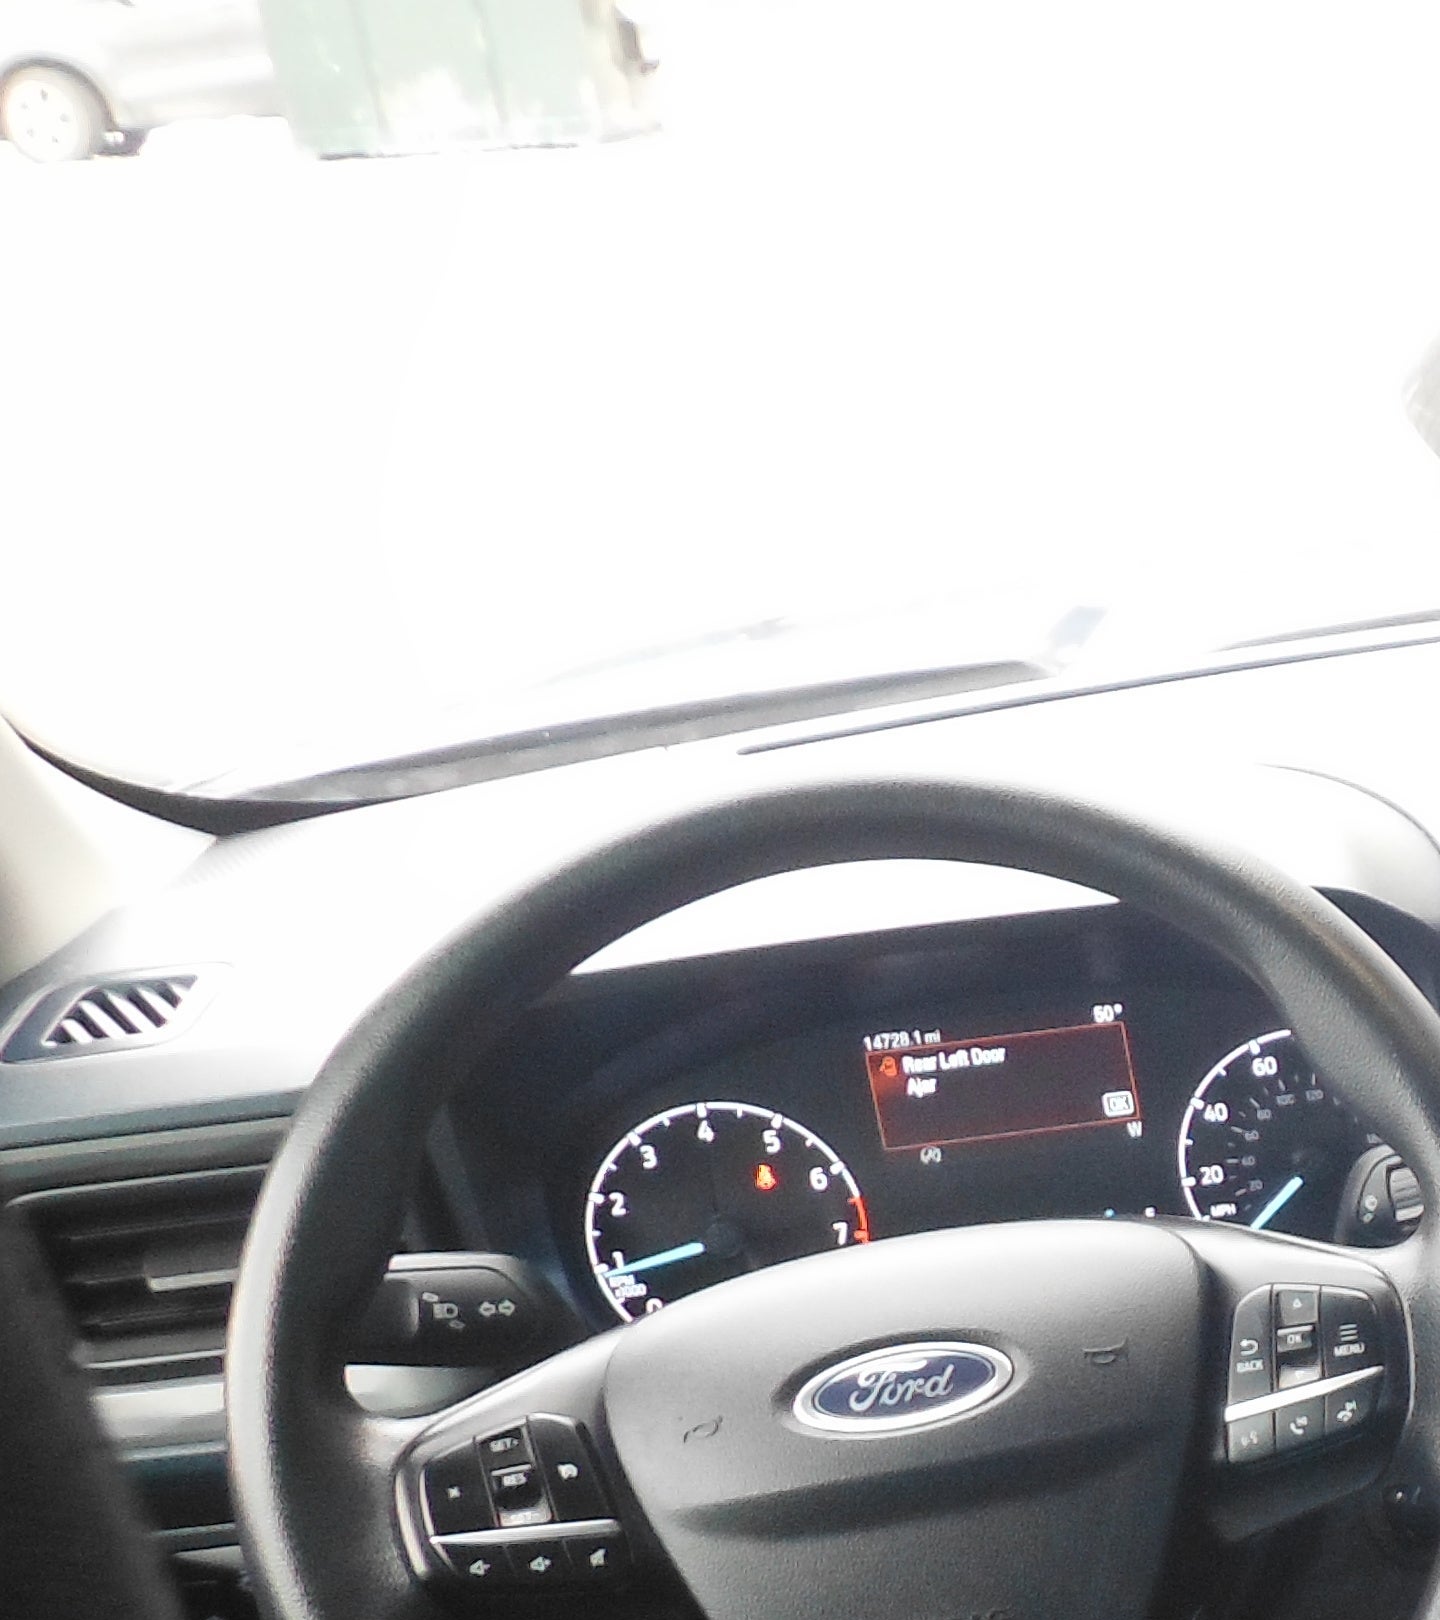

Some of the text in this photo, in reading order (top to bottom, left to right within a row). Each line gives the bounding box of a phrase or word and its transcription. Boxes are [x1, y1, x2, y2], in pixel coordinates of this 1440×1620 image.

[970, 1047, 1006, 1066] Door
[1251, 1056, 1278, 1077] 60
[906, 1077, 937, 1098] Ajar
[1203, 1102, 1228, 1122] 40
[697, 1120, 715, 1143] 4
[762, 1129, 781, 1154] 5
[640, 1145, 658, 1169] 3
[809, 1166, 828, 1191] 6
[1201, 1165, 1224, 1185] 20
[609, 1192, 627, 1217] 2
[1209, 1203, 1237, 1217] MPH
[832, 1222, 848, 1245] 7
[1333, 1342, 1365, 1357] MENU
[1236, 1359, 1263, 1373] BACK
[849, 1363, 955, 1412] Ford
